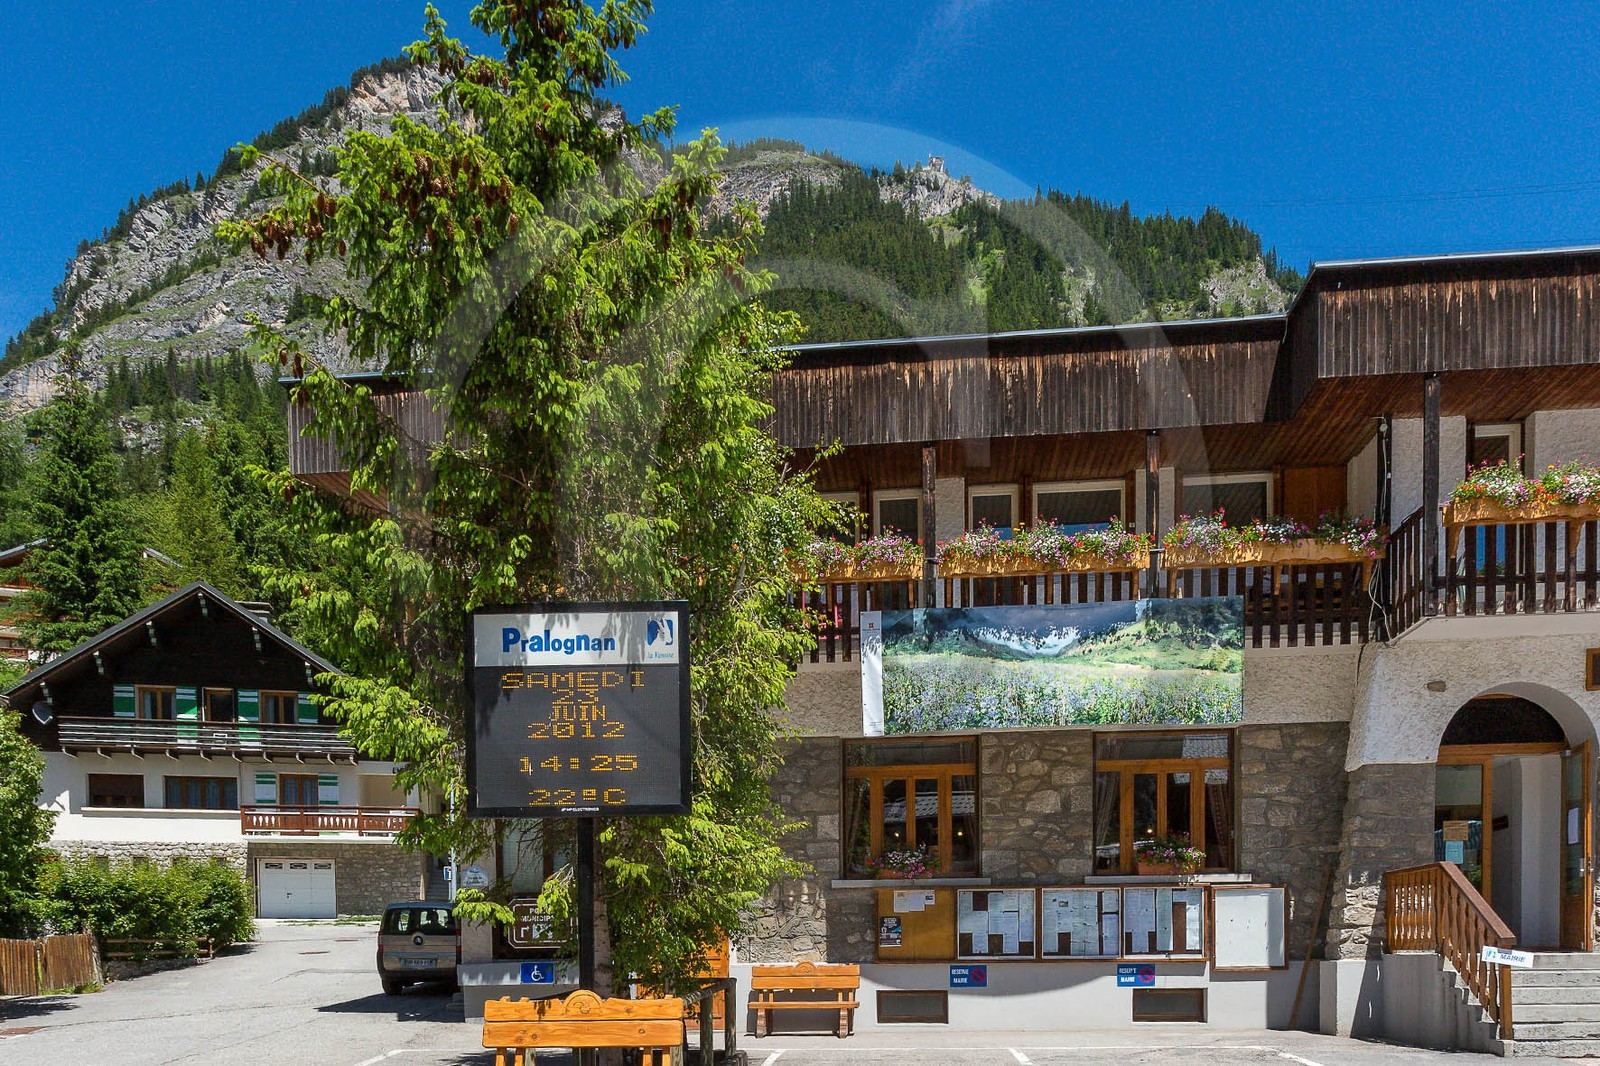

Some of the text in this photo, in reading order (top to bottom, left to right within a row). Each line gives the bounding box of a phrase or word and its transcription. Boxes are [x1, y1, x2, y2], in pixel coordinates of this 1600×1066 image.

[502, 627, 616, 655] Pralognan
[501, 671, 645, 689] SAMEDI
[552, 689, 599, 705] 23
[549, 705, 606, 721] JUIN
[527, 721, 625, 739] 2012
[519, 755, 638, 772] 14:25
[1499, 954, 1526, 963] MAIRIE
